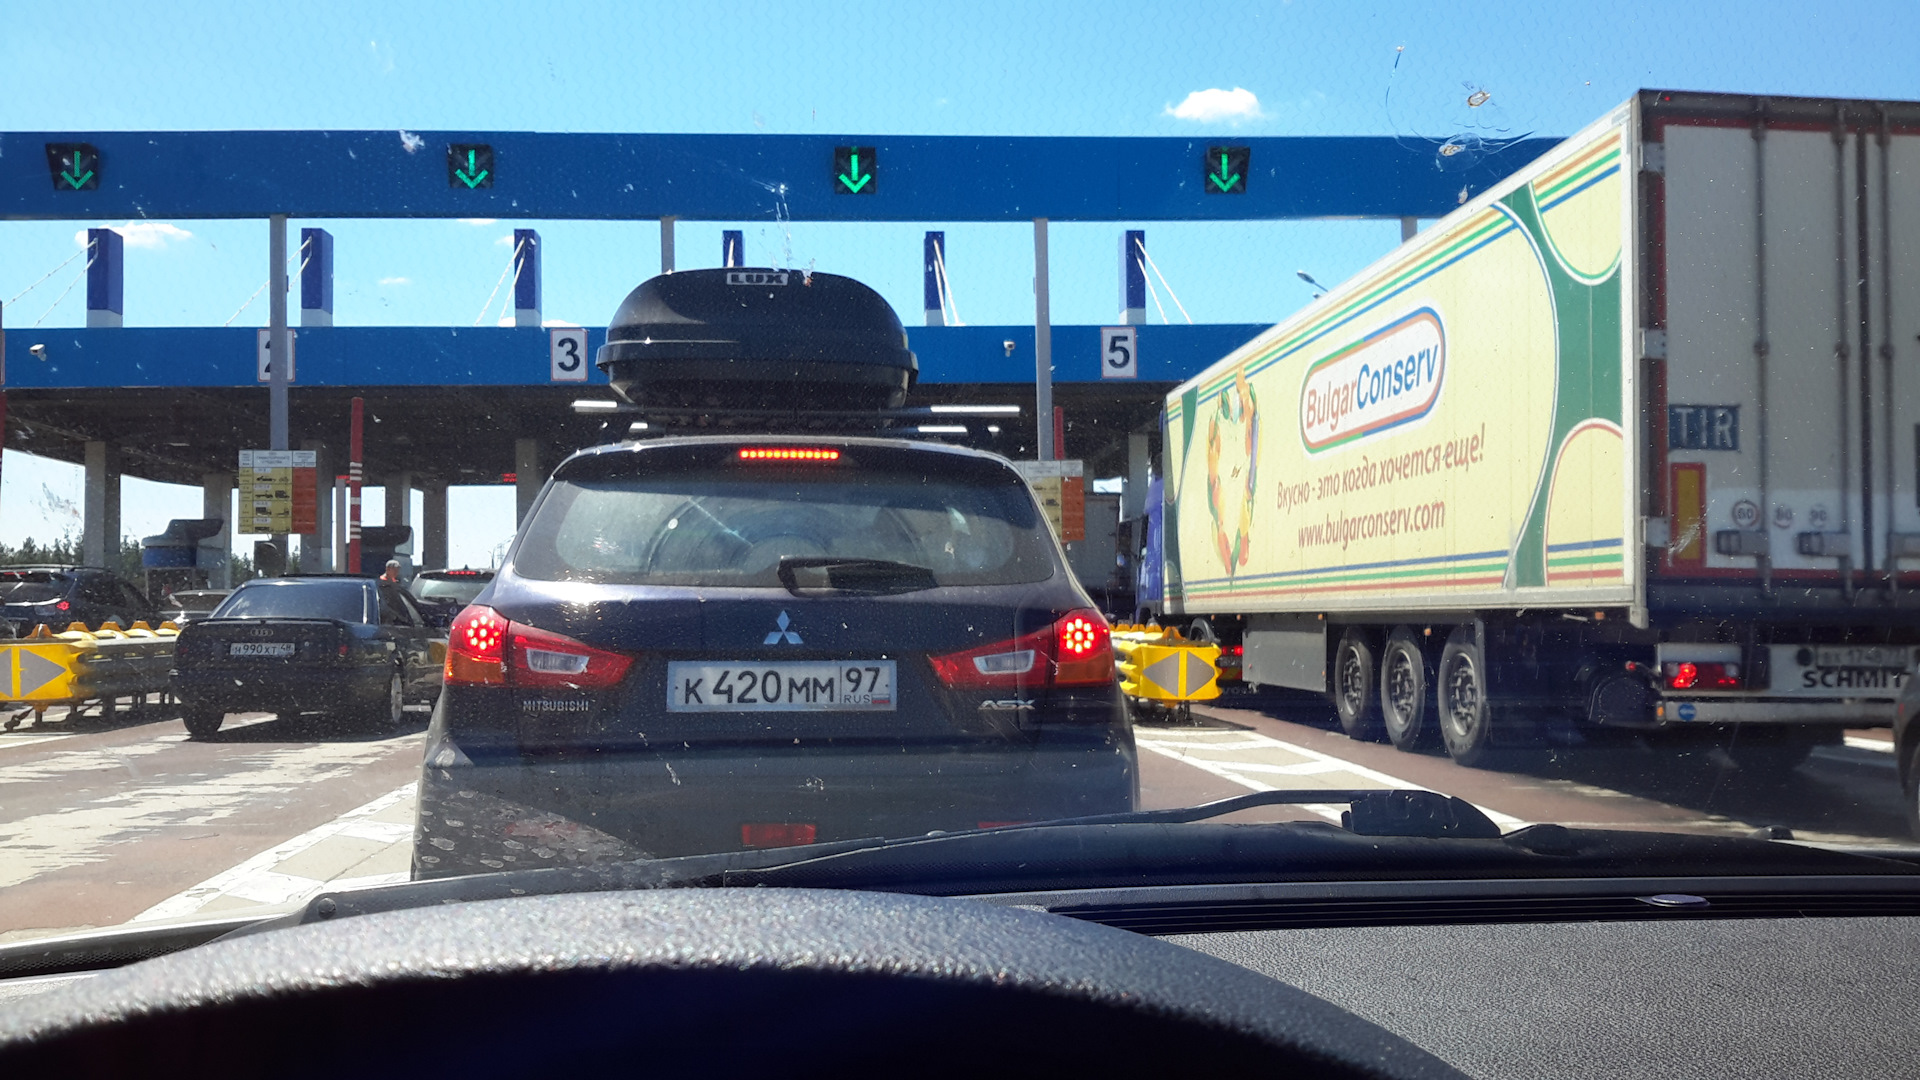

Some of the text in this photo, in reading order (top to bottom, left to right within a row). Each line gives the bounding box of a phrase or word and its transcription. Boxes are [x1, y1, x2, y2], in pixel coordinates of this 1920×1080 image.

[731, 274, 783, 284] LUX
[558, 337, 581, 372] 3
[1108, 335, 1130, 369] 5
[1306, 344, 1438, 431] BulgarConserv
[1675, 408, 1733, 448] TIR
[1277, 481, 1310, 515] Вкусно
[1317, 474, 1341, 501] это
[1342, 456, 1377, 493] когда
[1378, 442, 1442, 486] хочется
[1444, 422, 1486, 473] еще!
[1298, 501, 1446, 551] www.bulgarconserv.com
[846, 667, 880, 693] 97
[523, 700, 589, 711] MITSUBISHI
[844, 694, 871, 704] RUS
[978, 699, 1036, 710] ASX
